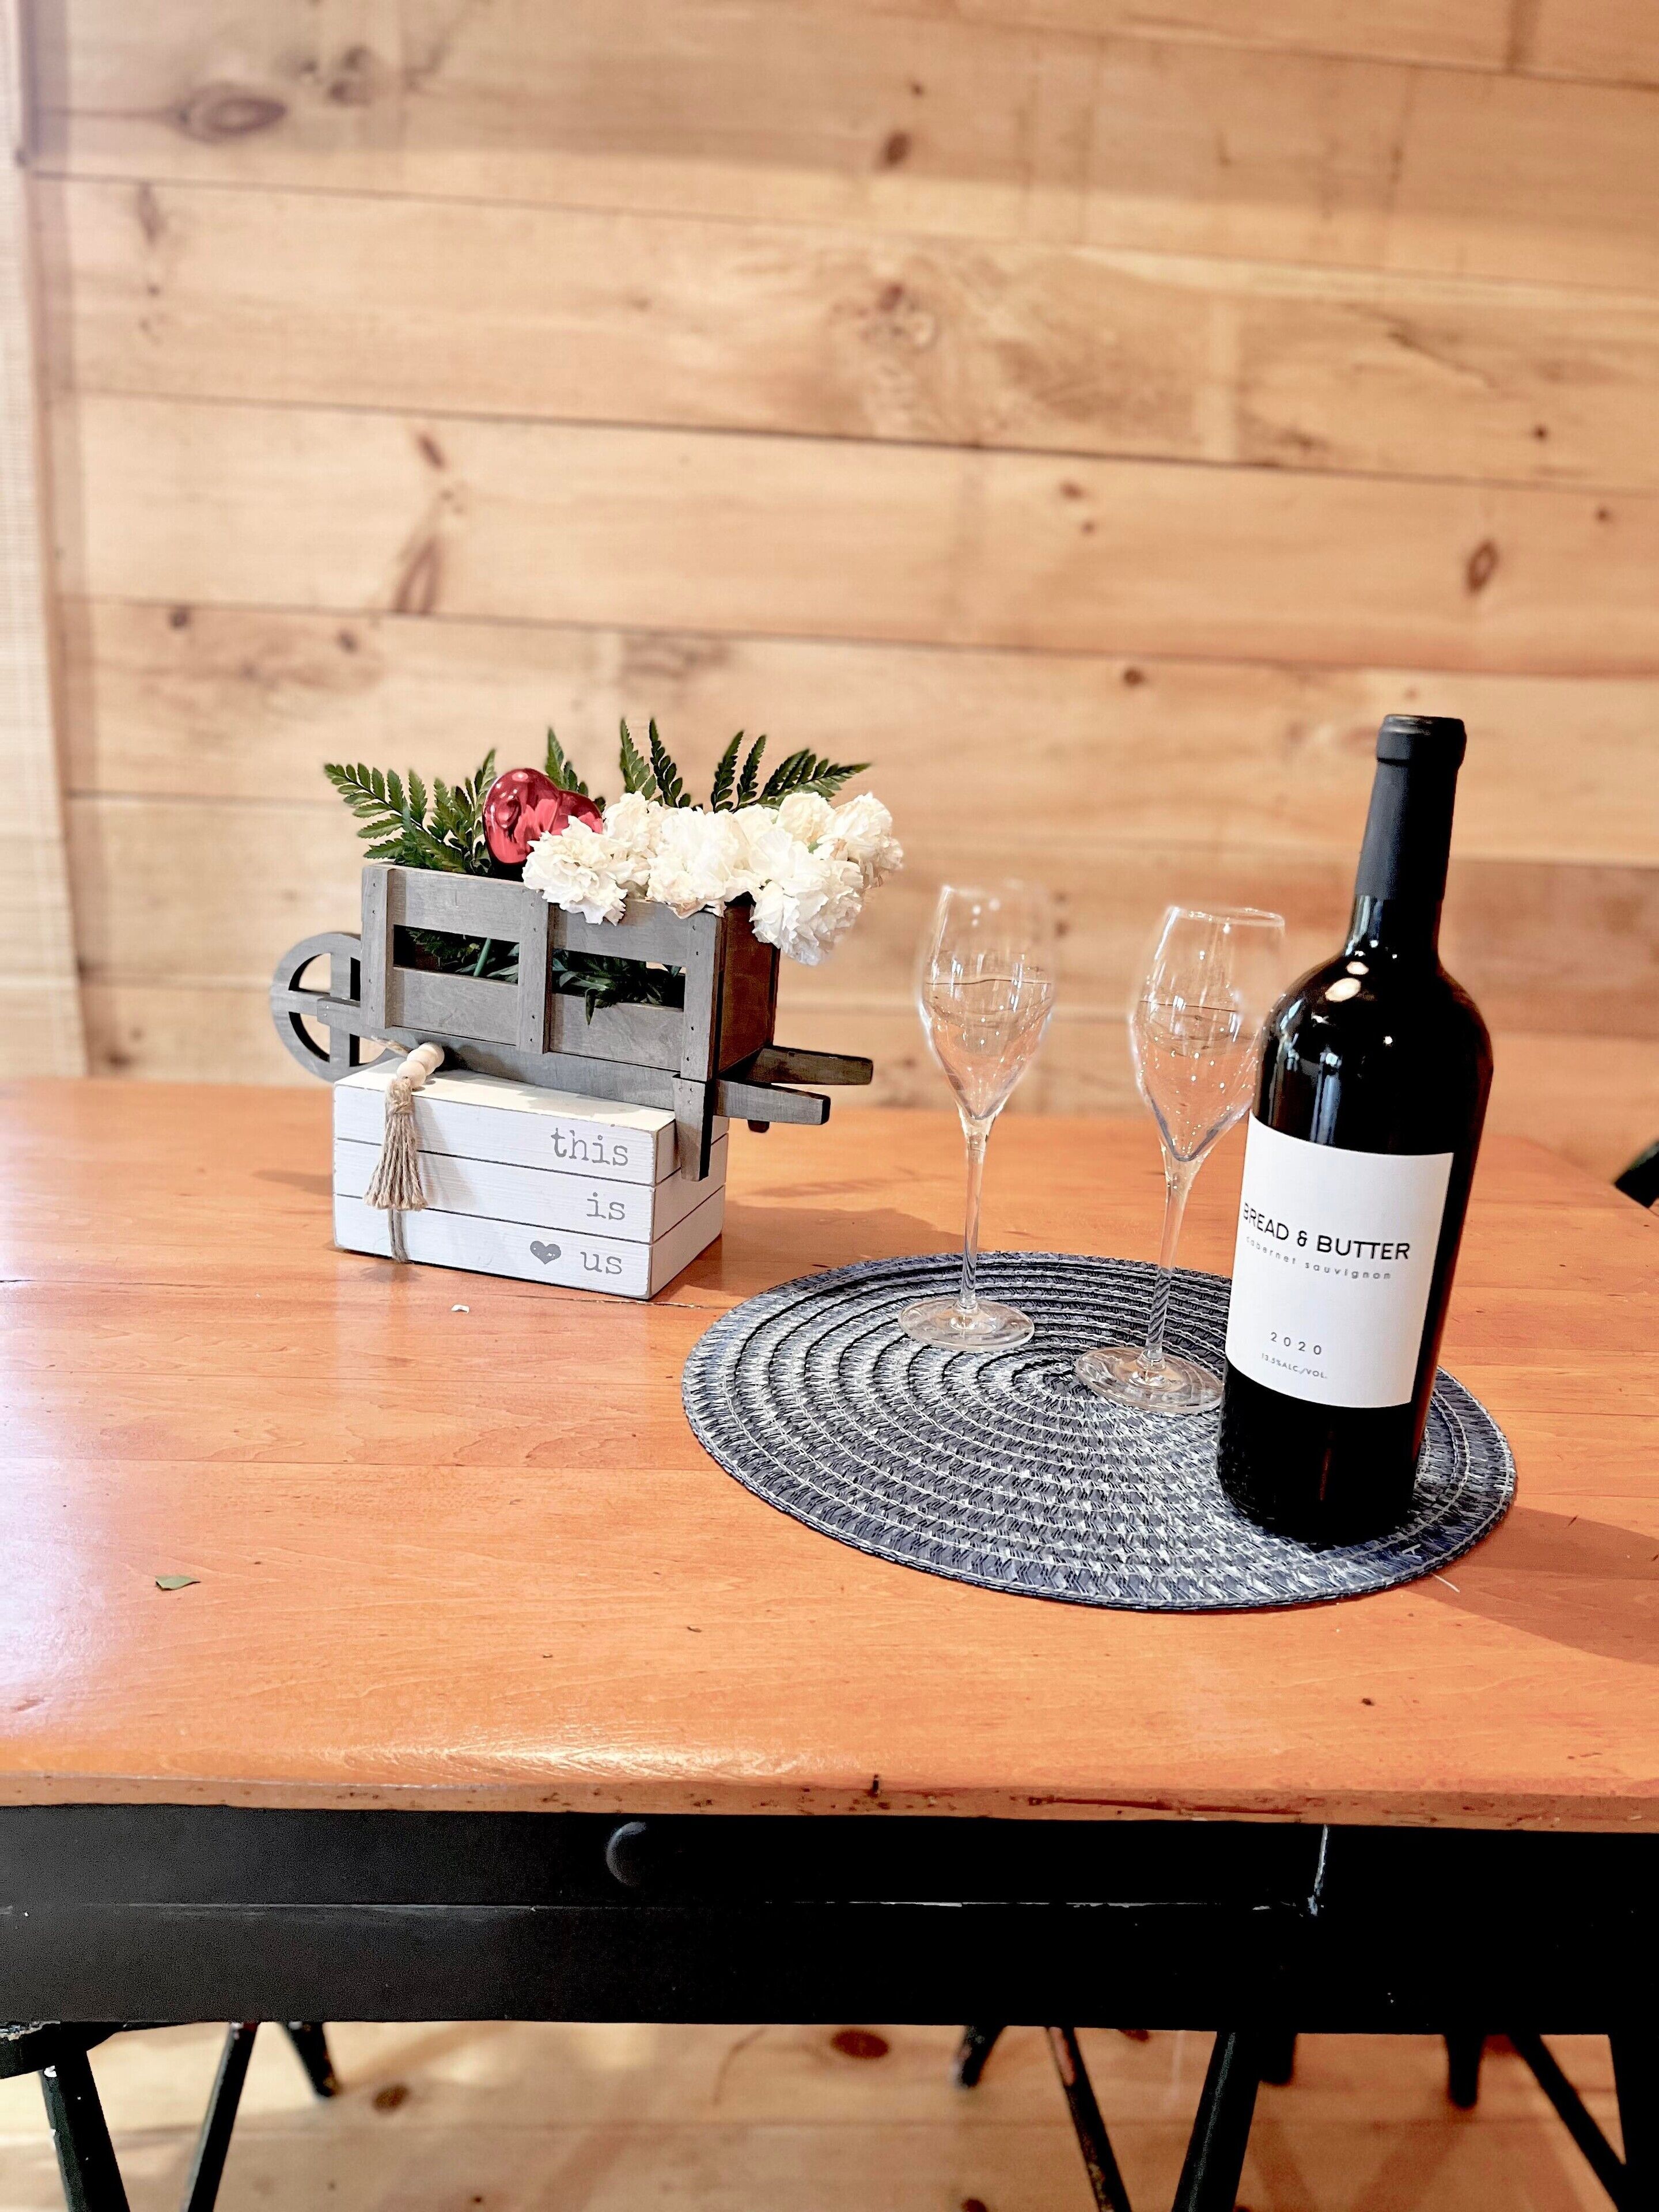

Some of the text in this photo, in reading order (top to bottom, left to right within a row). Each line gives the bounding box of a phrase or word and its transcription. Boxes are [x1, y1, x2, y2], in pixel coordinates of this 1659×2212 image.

[551, 1127, 628, 1166] this
[586, 1192, 625, 1220] is
[1243, 1202, 1410, 1260] BREAD & BUTTER
[580, 1251, 623, 1275] us
[1246, 1236, 1391, 1279] cabernet sauvignon
[1270, 1332, 1322, 1355] 2020
